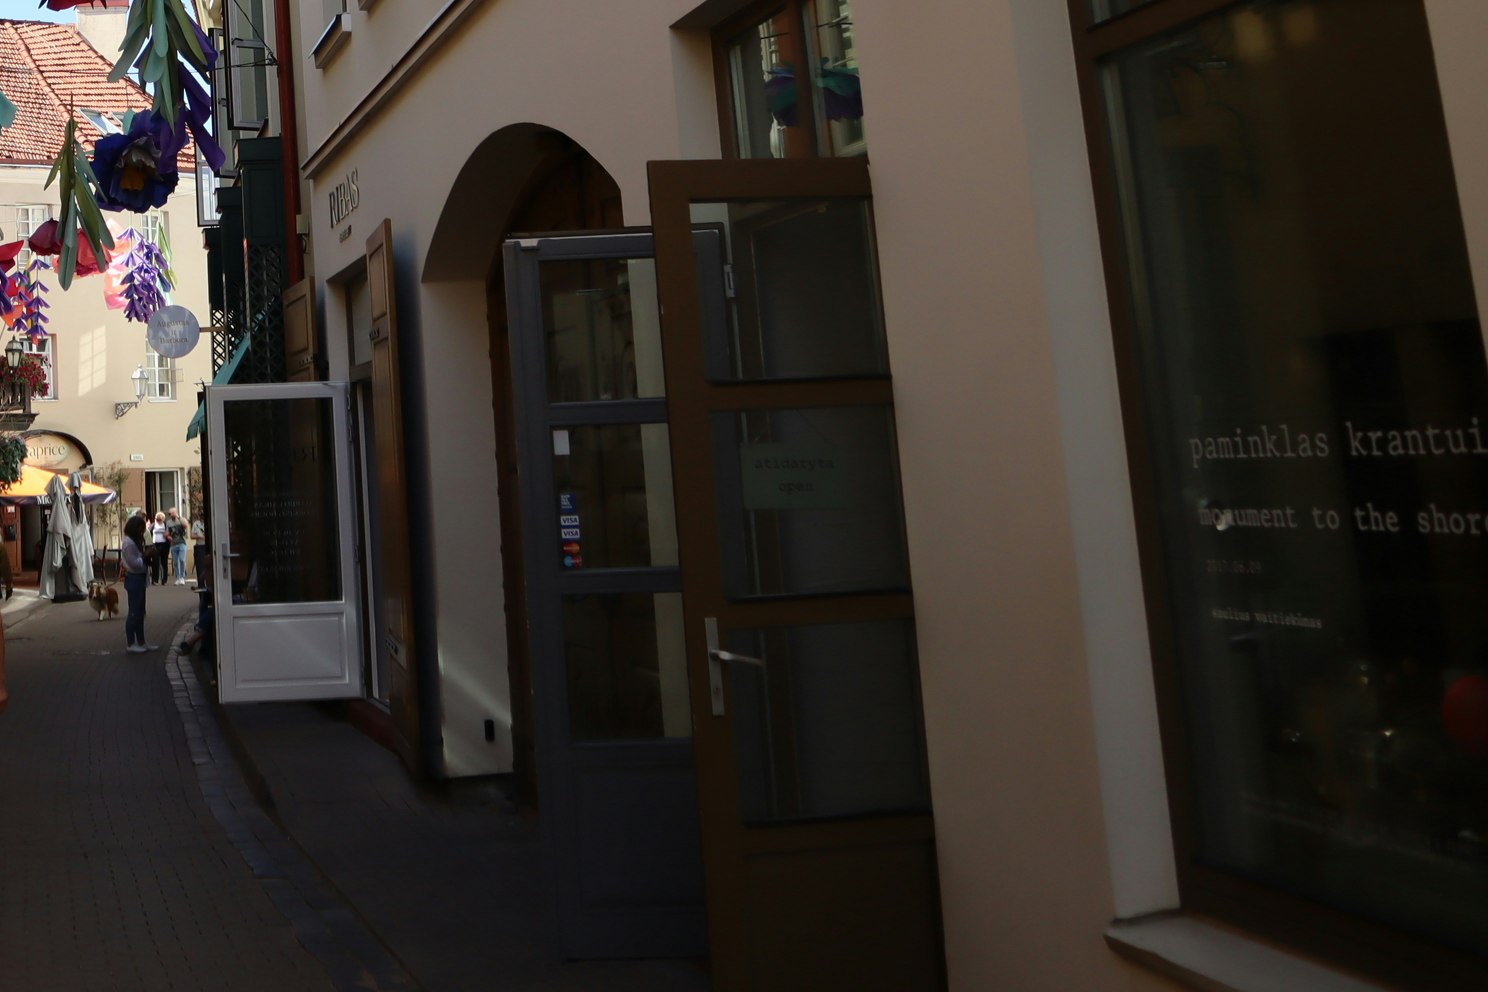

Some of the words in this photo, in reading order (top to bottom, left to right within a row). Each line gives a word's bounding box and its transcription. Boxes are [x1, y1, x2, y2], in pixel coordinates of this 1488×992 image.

[328, 167, 360, 230] RIBAS
[29, 443, 66, 459] aprice
[1189, 425, 1330, 469] paminklas
[1343, 417, 1488, 457] krantui
[777, 482, 815, 496] open
[1312, 507, 1341, 530] to
[1354, 504, 1401, 533] the
[1417, 504, 1488, 535] shor
